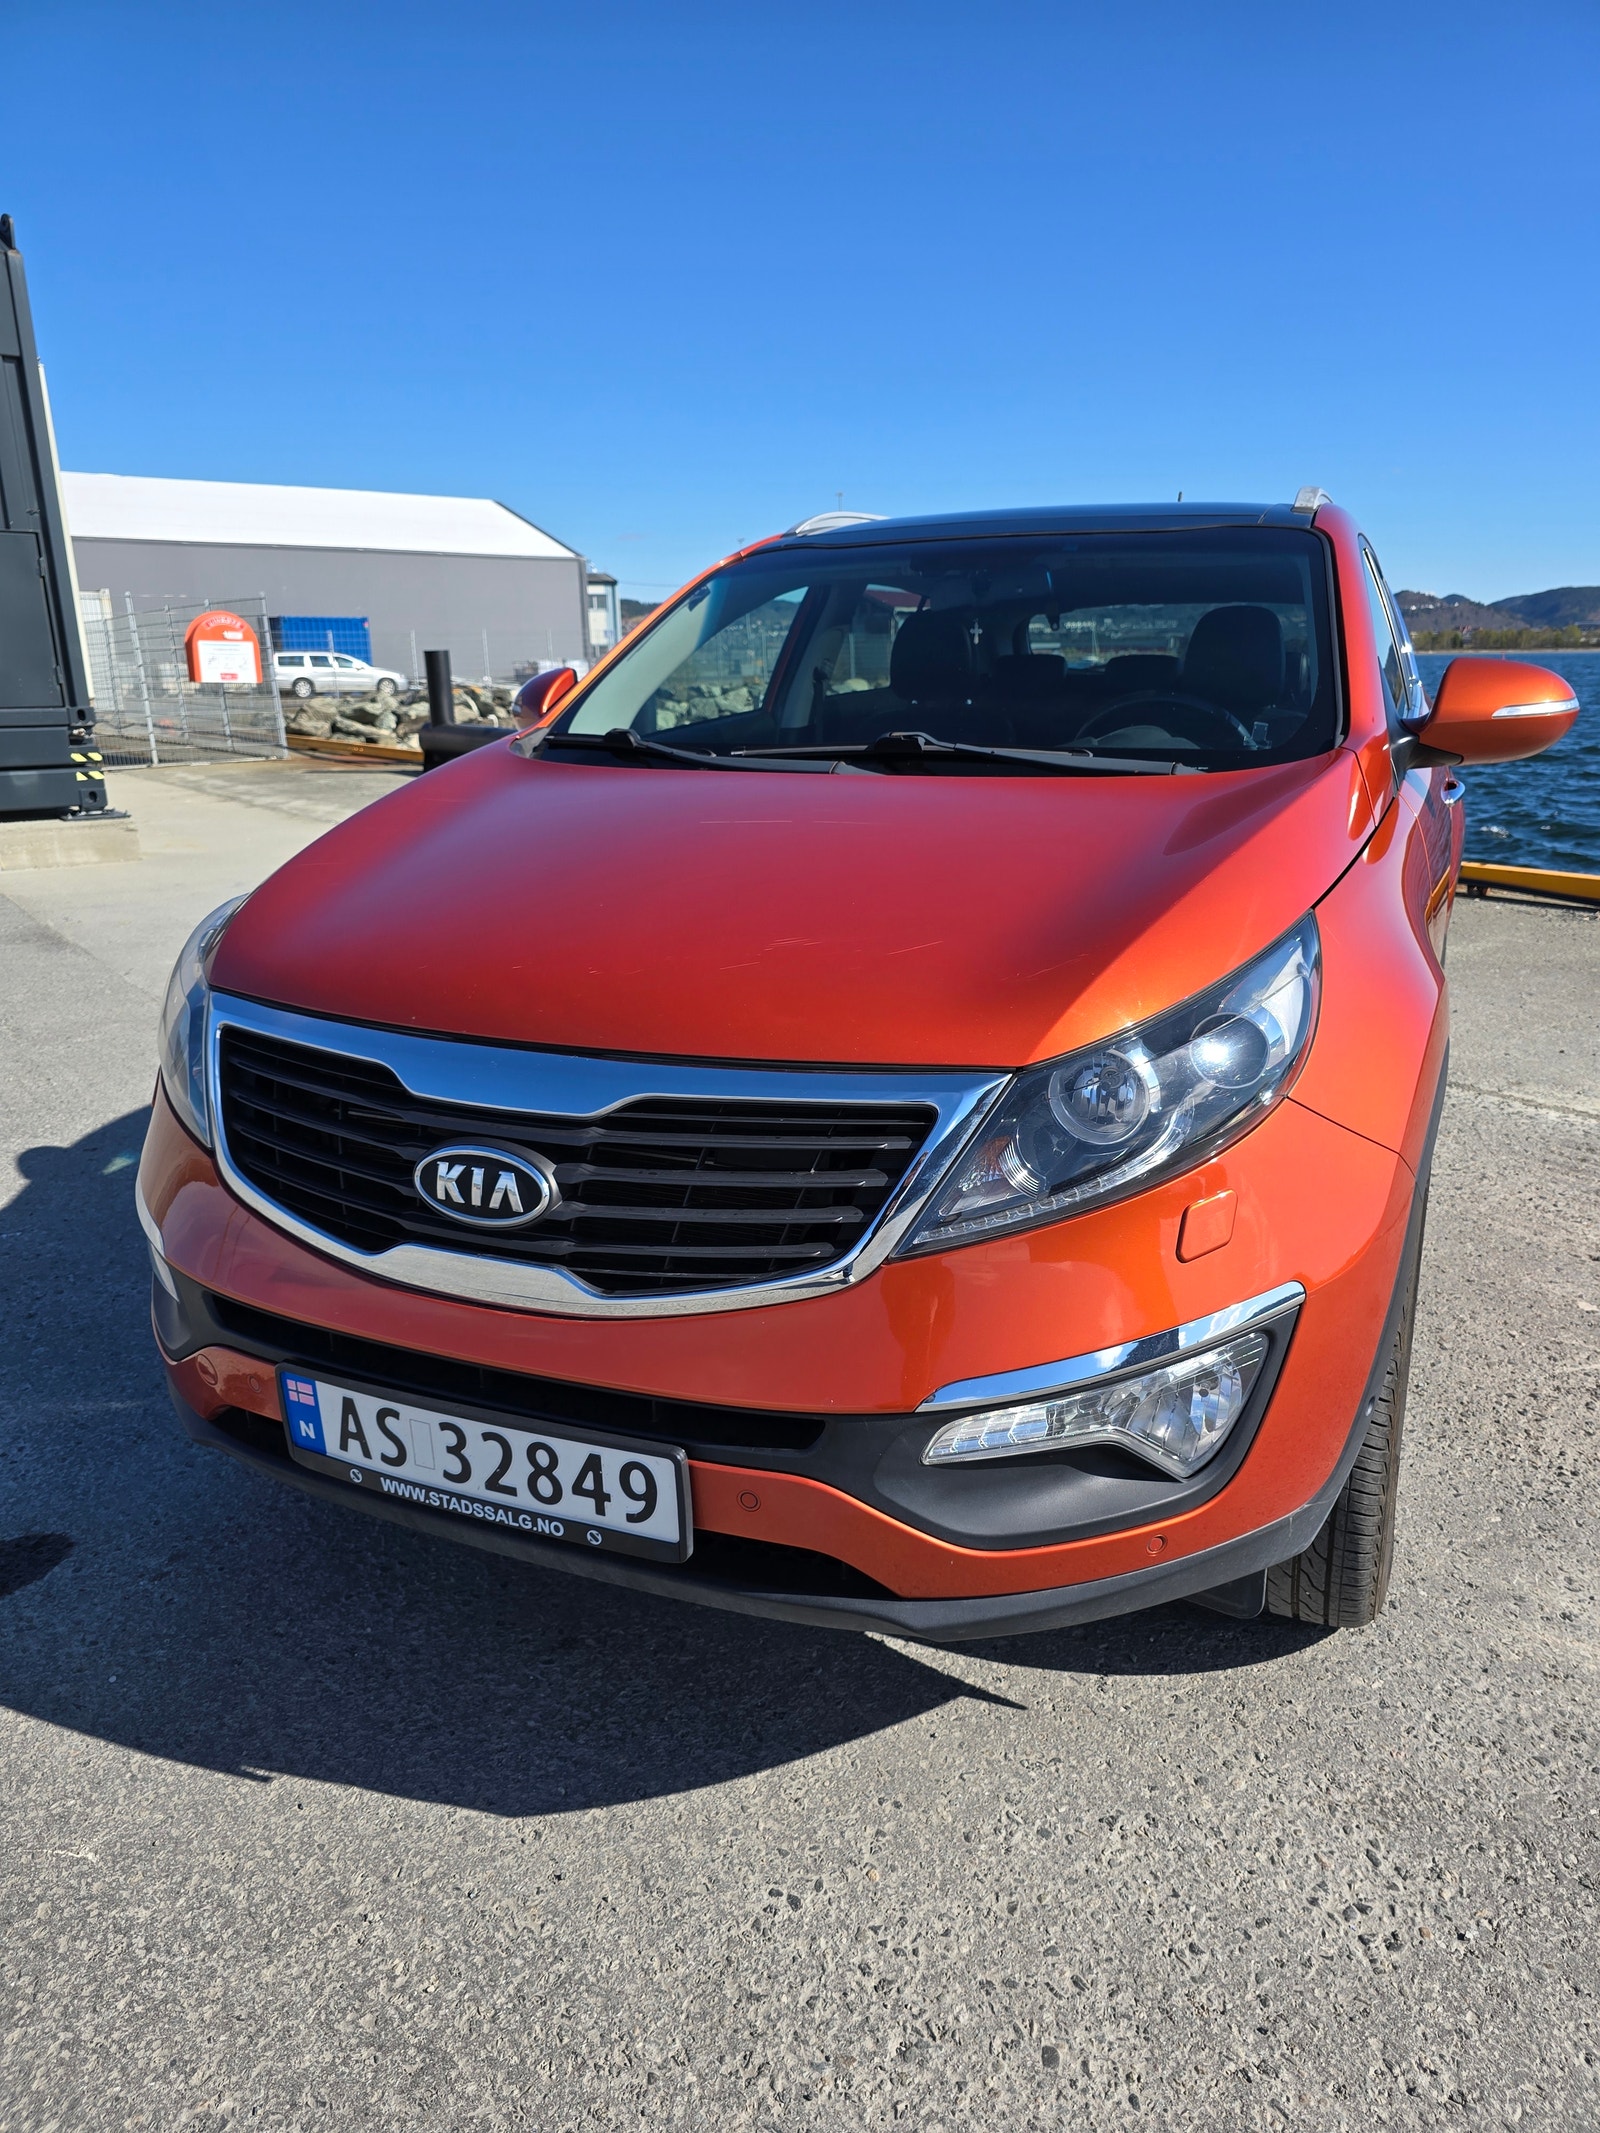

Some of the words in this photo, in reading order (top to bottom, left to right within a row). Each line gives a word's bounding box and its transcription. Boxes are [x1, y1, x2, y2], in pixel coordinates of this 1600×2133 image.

[436, 1161, 524, 1213] KIA
[299, 1418, 316, 1440] N
[338, 1396, 408, 1468] AS
[438, 1421, 658, 1524] 32849
[380, 1476, 565, 1538] WWW.STADSSALG.NO
